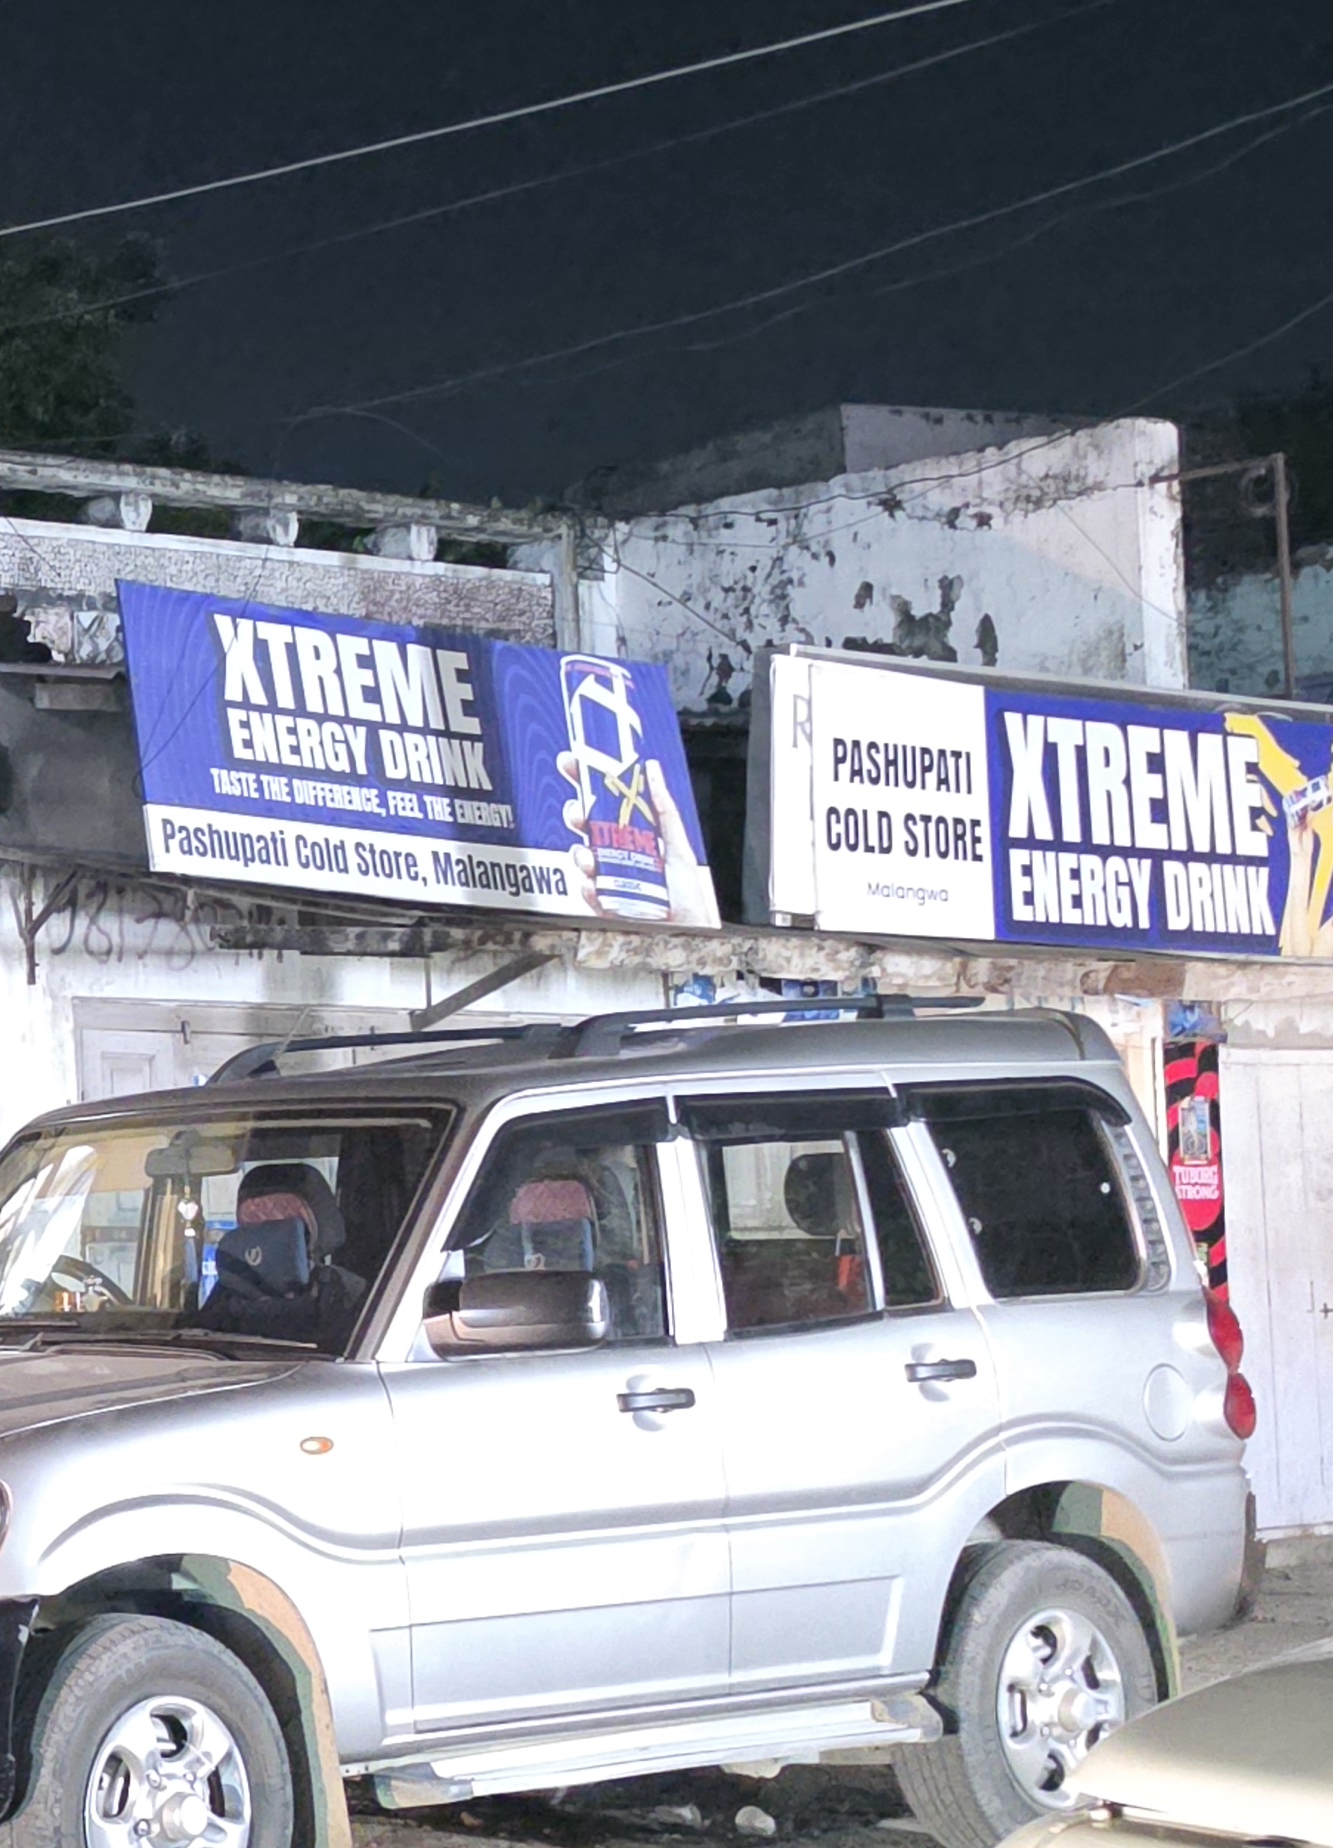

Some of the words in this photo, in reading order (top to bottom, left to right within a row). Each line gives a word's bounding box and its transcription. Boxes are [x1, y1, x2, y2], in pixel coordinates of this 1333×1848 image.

[213, 613, 482, 735] XTREME
[227, 707, 368, 775] ENERGY
[378, 729, 493, 791] DRINK
[832, 736, 973, 795] PASHUPATI
[1003, 711, 1269, 857] XTREME
[210, 768, 259, 799] TASTE
[260, 772, 291, 802] THE
[292, 778, 387, 818] DIFFERENCE,
[387, 789, 424, 819] FEEL
[424, 794, 454, 822] THE
[454, 798, 515, 829] ENERGY!
[825, 805, 893, 855] COLD
[903, 812, 984, 862] STORE
[161, 817, 289, 869] Pashupati
[295, 835, 348, 875] Cold
[356, 842, 428, 887] Store,
[432, 850, 569, 897] Malangawa
[867, 882, 949, 906] Malangwa
[1009, 848, 1152, 929] ENERGY
[1162, 860, 1276, 936] DRINK
